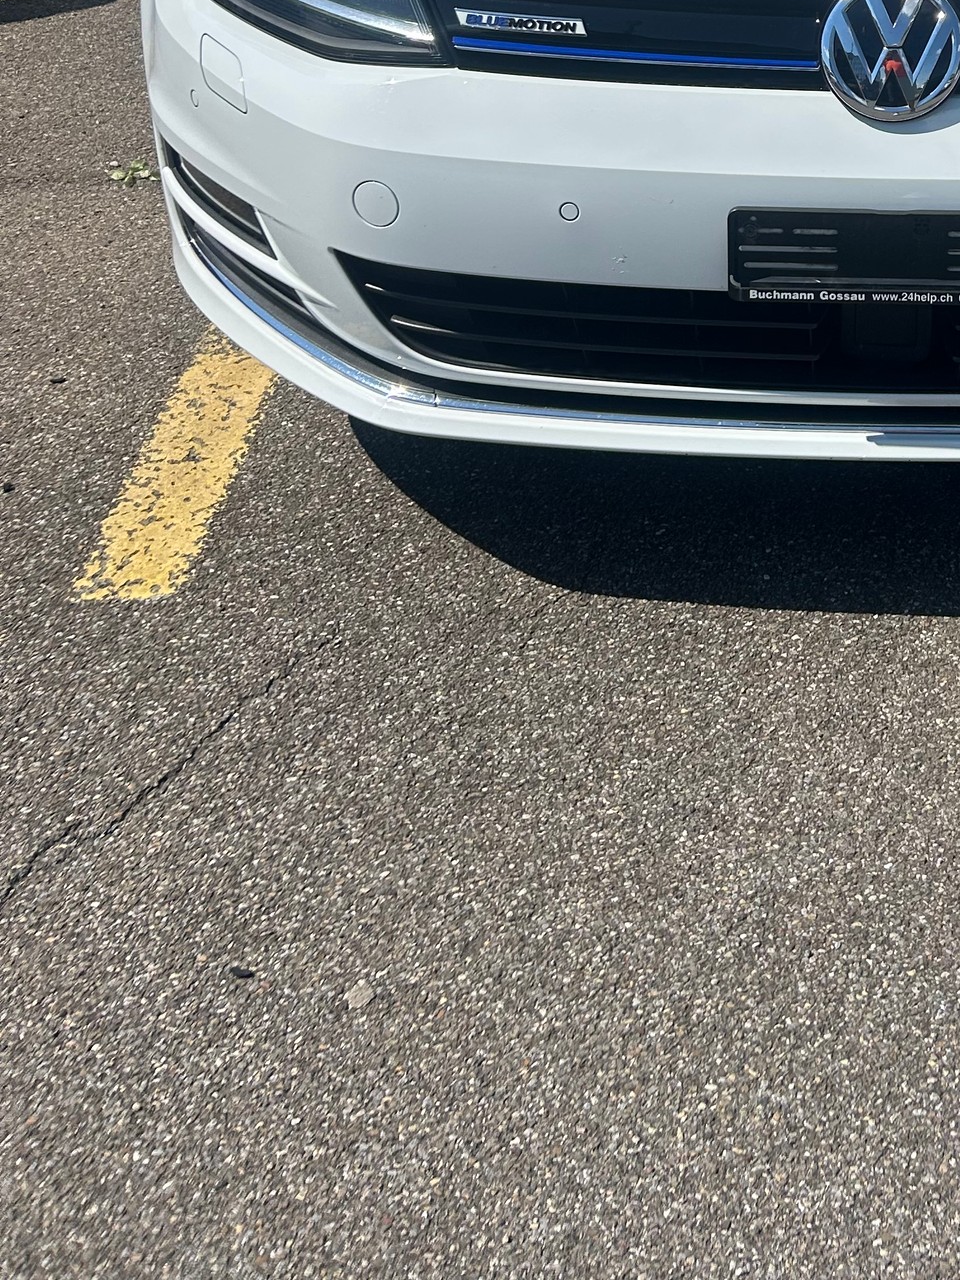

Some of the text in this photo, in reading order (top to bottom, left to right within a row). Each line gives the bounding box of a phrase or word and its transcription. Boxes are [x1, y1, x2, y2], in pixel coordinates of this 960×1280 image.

[465, 13, 577, 33] BLUEMOTION
[749, 289, 815, 300] Buchmann
[819, 290, 866, 301] Gossau
[872, 292, 954, 305] www.24help.ch
